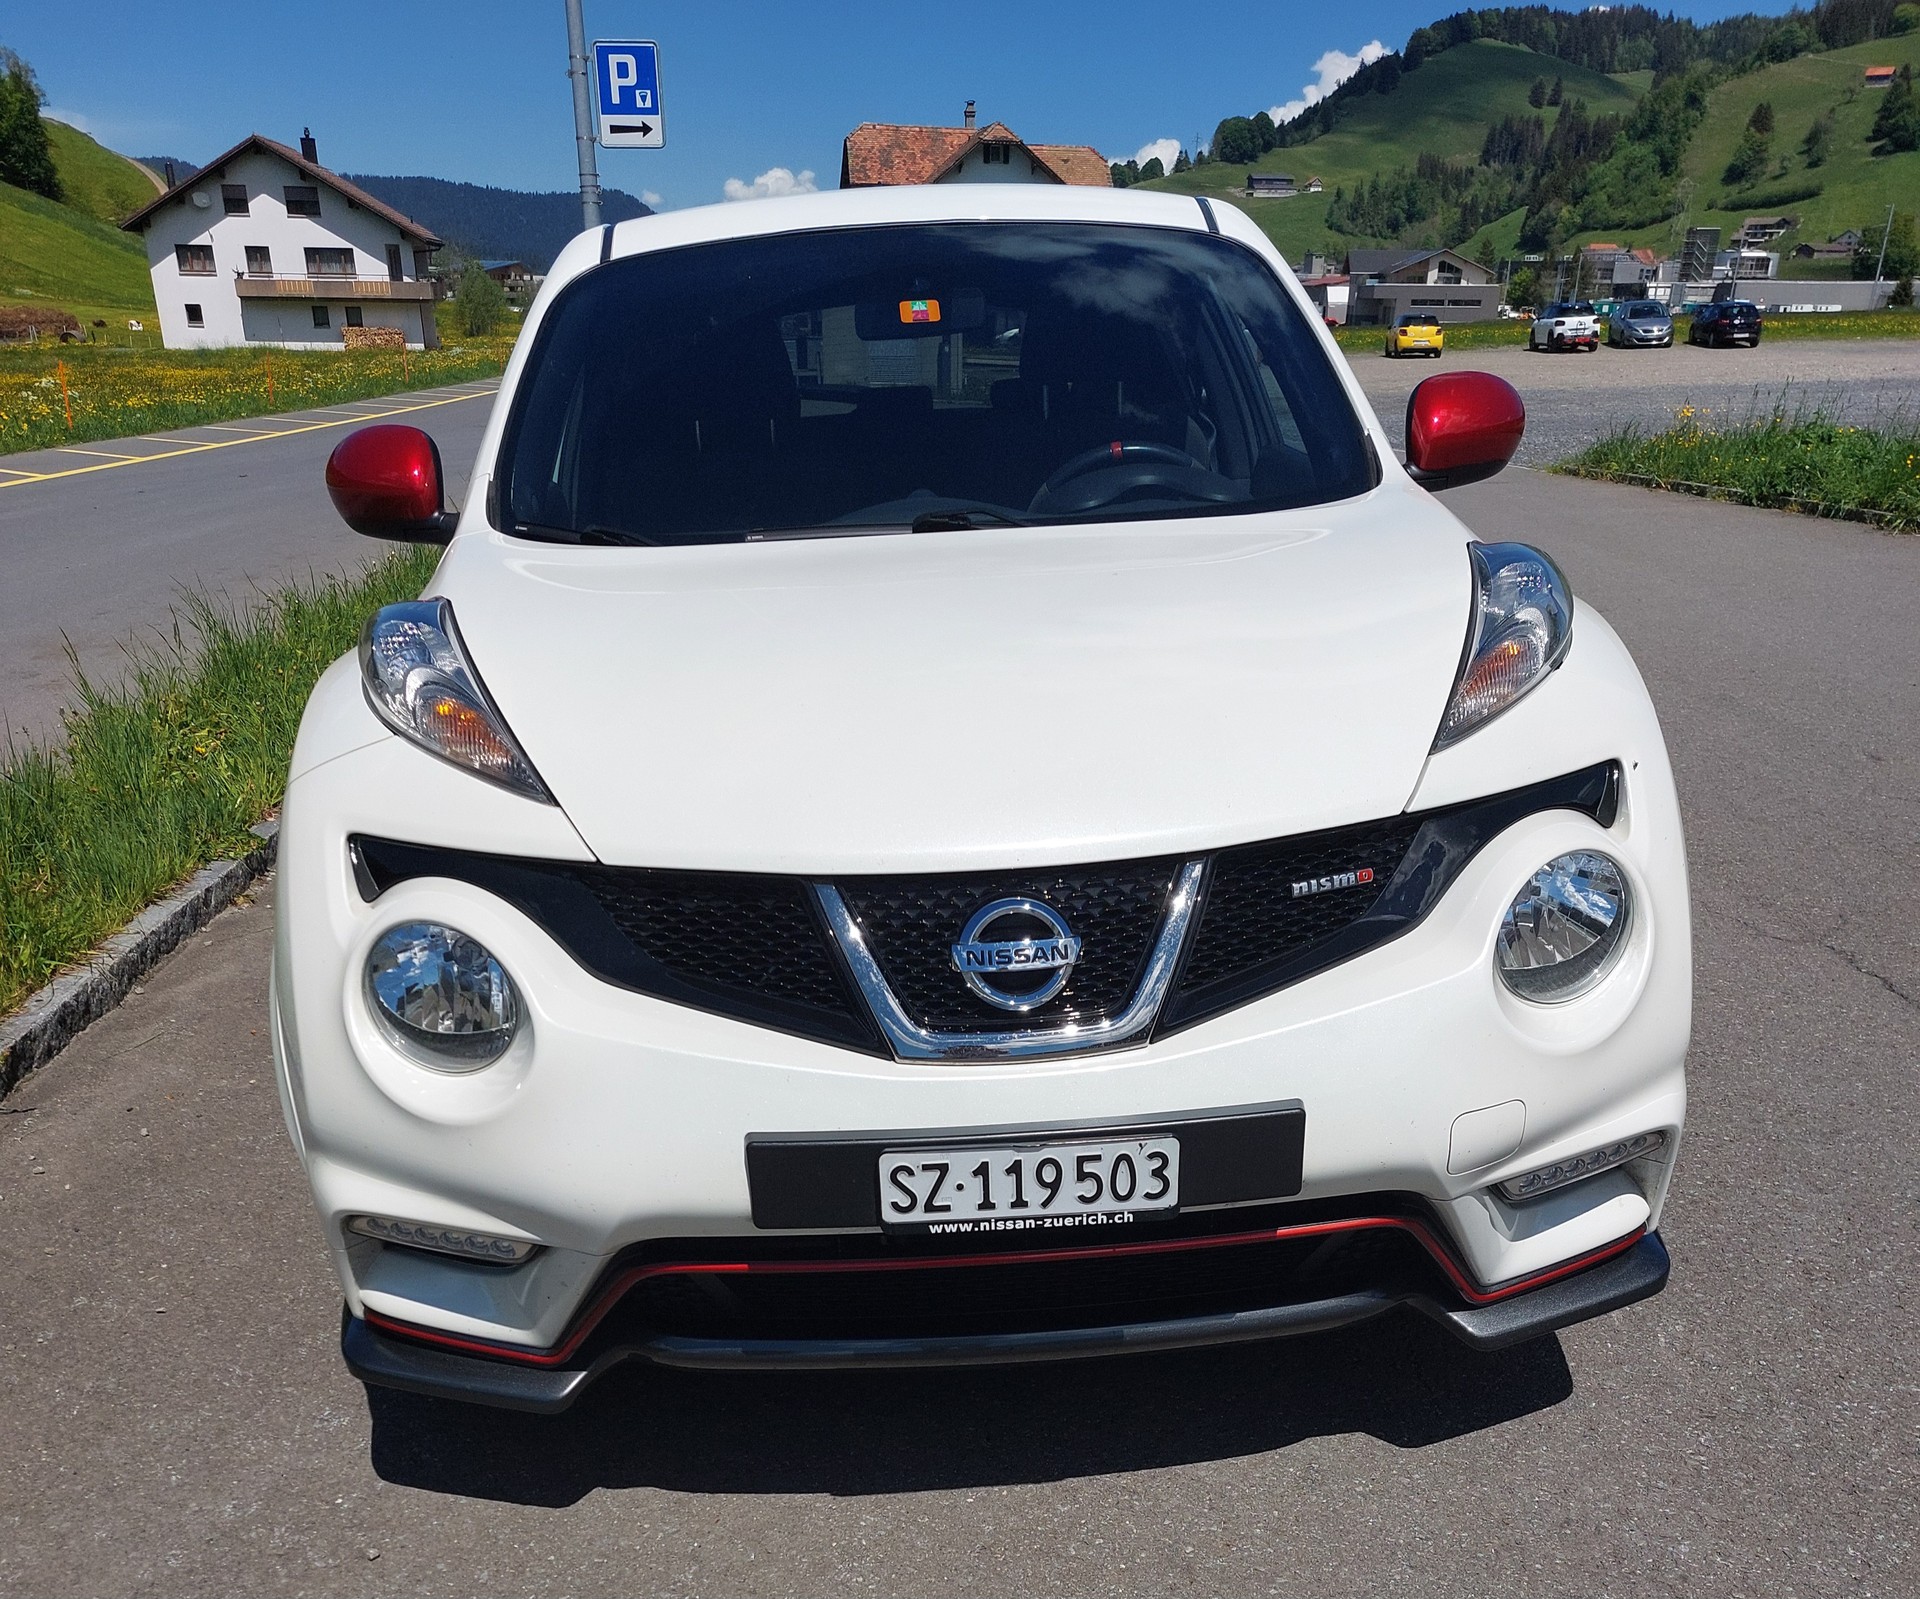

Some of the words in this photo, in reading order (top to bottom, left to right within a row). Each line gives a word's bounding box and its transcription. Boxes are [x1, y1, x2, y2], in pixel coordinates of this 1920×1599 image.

[608, 53, 637, 105] P
[965, 944, 1069, 967] NISSAN
[928, 1211, 1134, 1234] www.nissan-zuerich.ch
